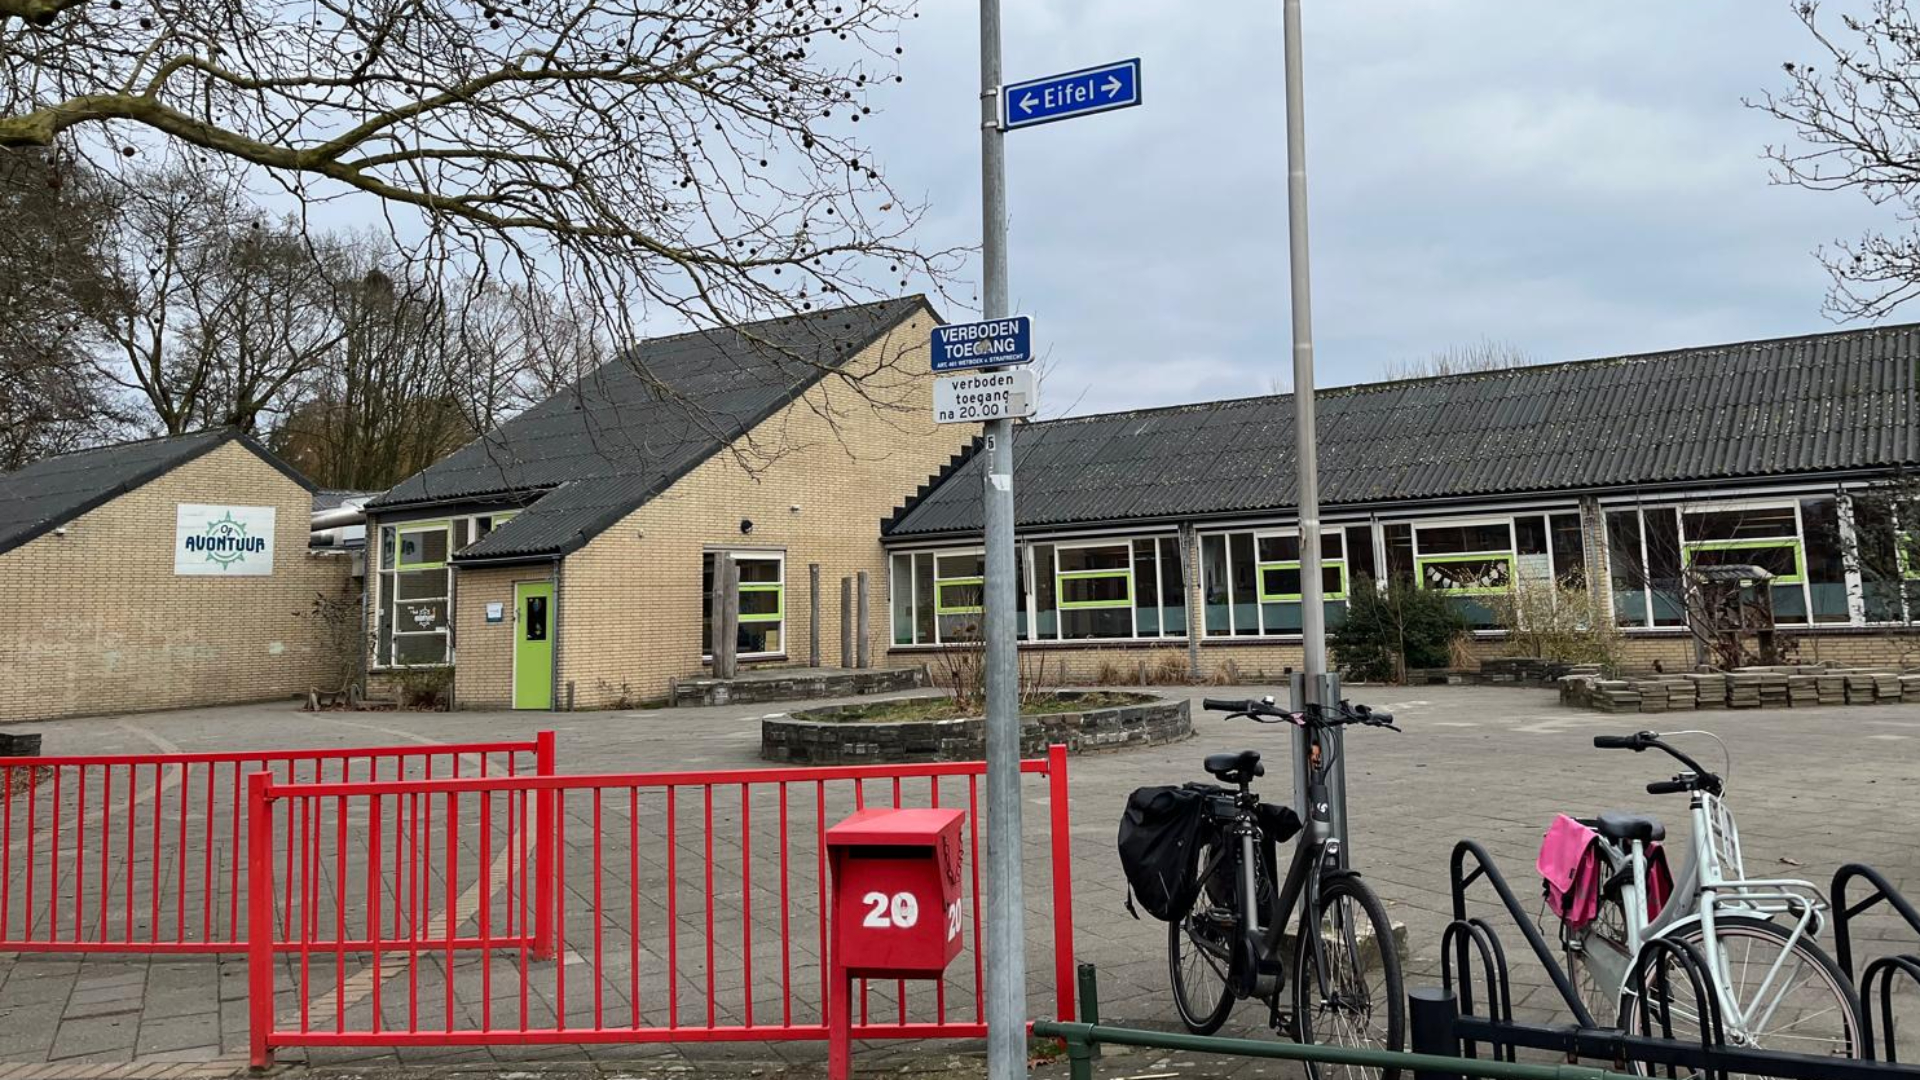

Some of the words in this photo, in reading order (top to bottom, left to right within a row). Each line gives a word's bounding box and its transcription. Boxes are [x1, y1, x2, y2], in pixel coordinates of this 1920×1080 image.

[1044, 79, 1094, 108] Eifel
[940, 320, 1019, 342] VERBODEN
[952, 375, 1014, 391] verboden
[956, 390, 1009, 406] toegang
[940, 410, 955, 420] na
[960, 403, 999, 419] 20.00
[185, 535, 265, 552] AVONTUUR
[862, 891, 919, 928] 20
[947, 897, 962, 943] 20
